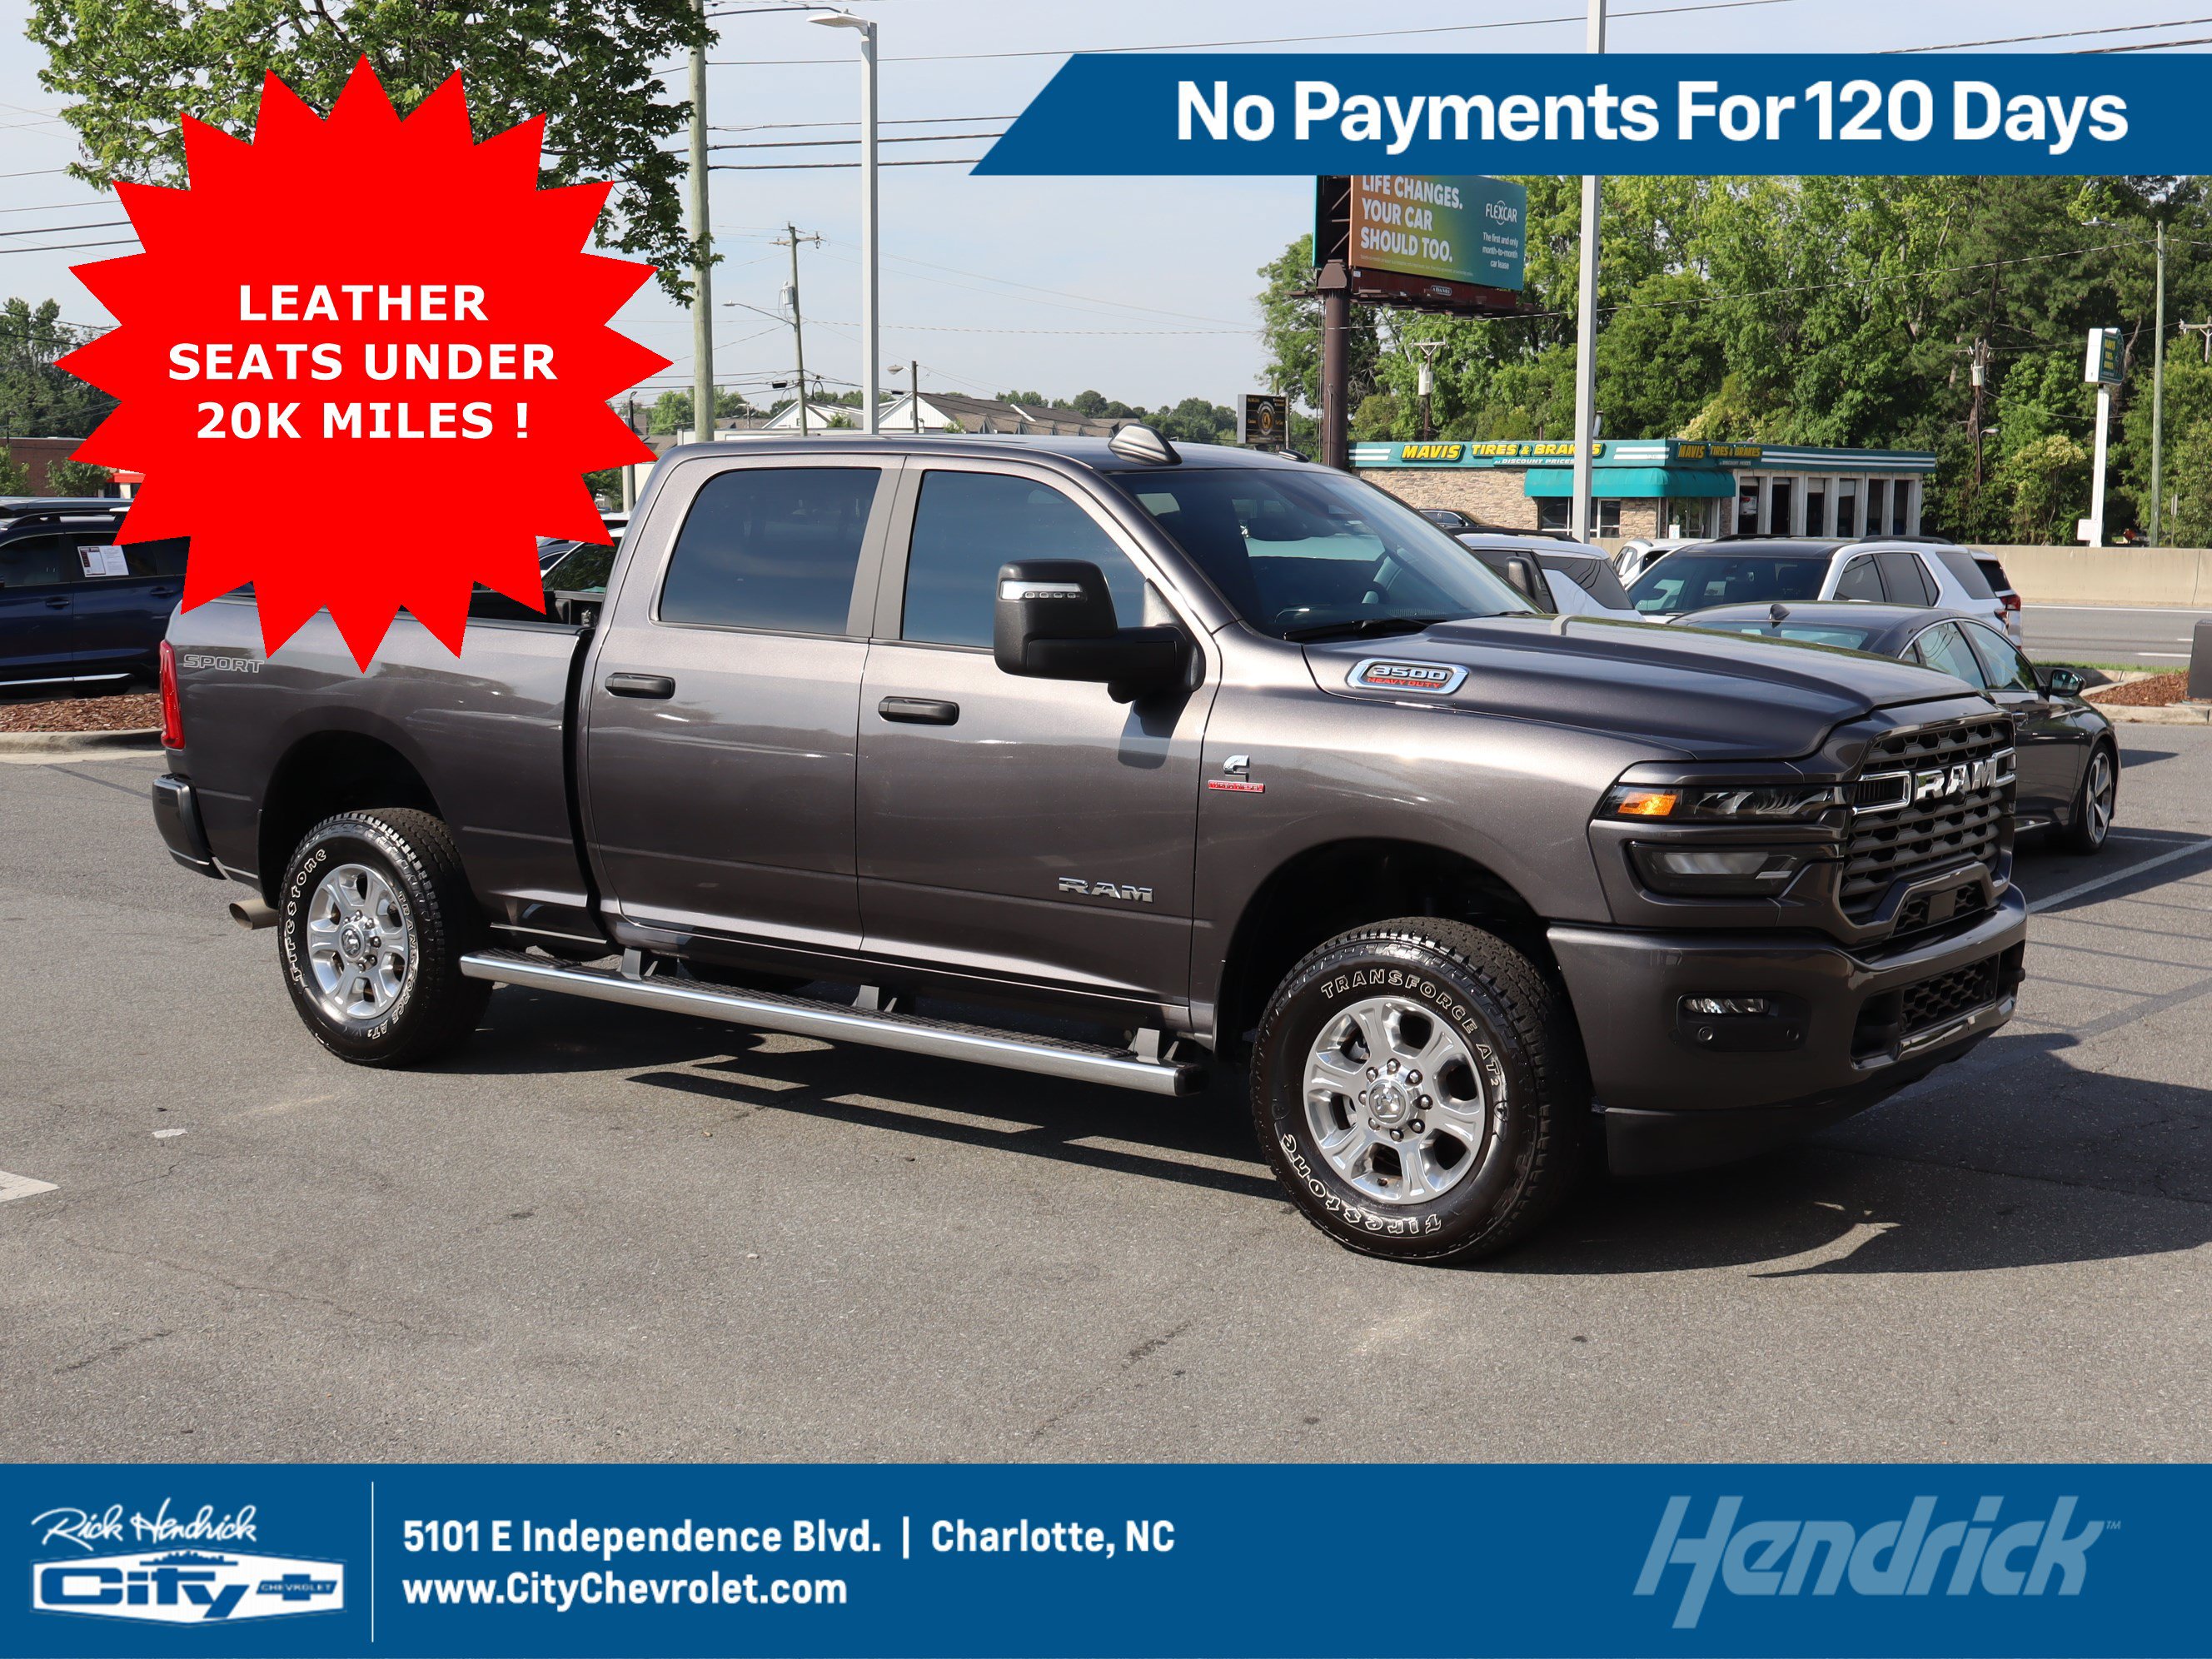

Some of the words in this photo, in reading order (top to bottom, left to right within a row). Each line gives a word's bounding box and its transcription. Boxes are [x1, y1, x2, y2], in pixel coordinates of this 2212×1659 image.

[1362, 175, 1391, 196] LIFE
[1394, 176, 1463, 210] CHANGES.
[1361, 197, 1402, 226] YOUR
[1404, 206, 1432, 232] CAR
[1485, 202, 1517, 223] FLEXCAR
[1360, 227, 1418, 257] SHOULD
[1422, 237, 1452, 263] TOO.
[1482, 232, 1492, 242] The
[1492, 233, 1501, 244] first
[1501, 237, 1510, 245] and
[1509, 238, 1519, 248] only
[1482, 246, 1518, 259] month-to-month
[1497, 260, 1510, 270] lease
[1401, 445, 1461, 459] MAVIS
[1472, 444, 1517, 455] TIRES
[1521, 446, 1531, 455] &
[1534, 443, 1602, 455] BRAKS
[1678, 445, 1705, 459] MAVIS
[1710, 446, 1729, 456] TIRES
[1734, 446, 1761, 457] BRAKES
[183, 655, 264, 673] SPORT
[1373, 666, 1447, 680] 3500
[1368, 677, 1406, 685] HEAVY
[1407, 680, 1442, 689] DUTY
[1916, 757, 1997, 800] RAM
[1059, 877, 1153, 902] RAM
[1321, 969, 1478, 1034] TRANSFORCE
